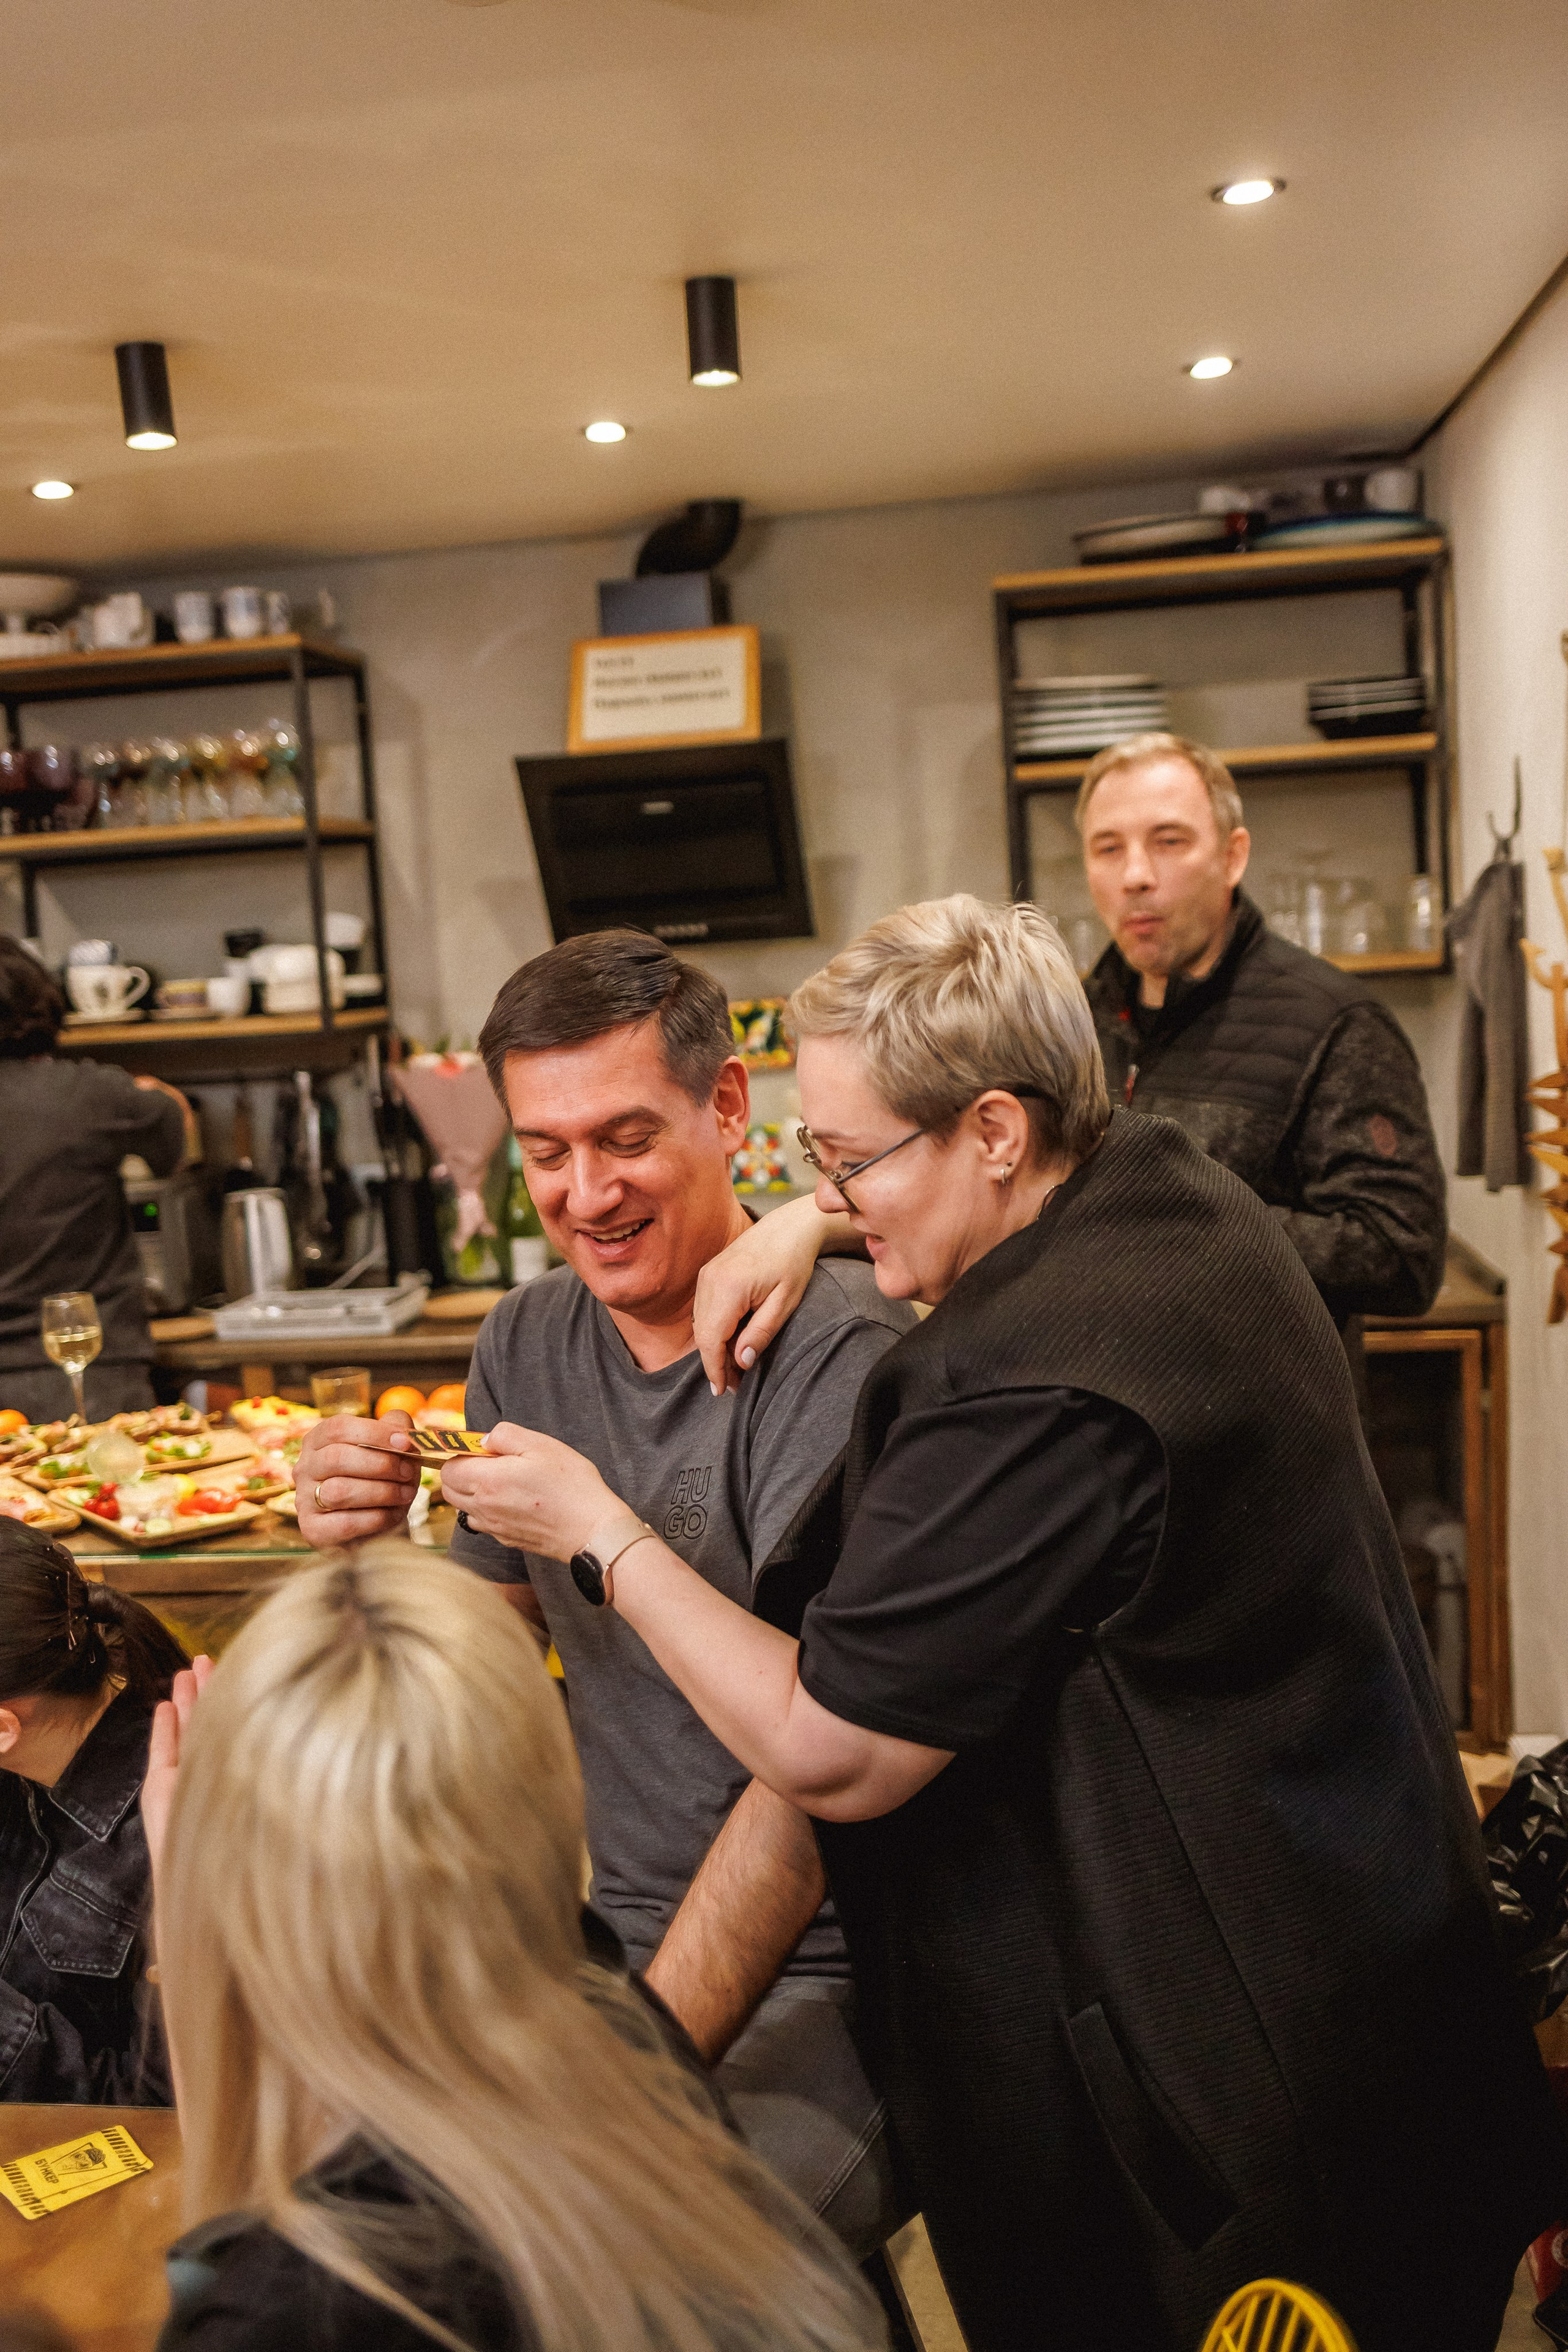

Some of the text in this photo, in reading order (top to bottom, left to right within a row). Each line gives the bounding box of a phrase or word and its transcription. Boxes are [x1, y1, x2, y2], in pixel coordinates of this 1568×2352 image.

[671, 1466, 712, 1504] HU
[664, 1504, 707, 1539] GO
[35, 2158, 59, 2184] БУНКЕР
